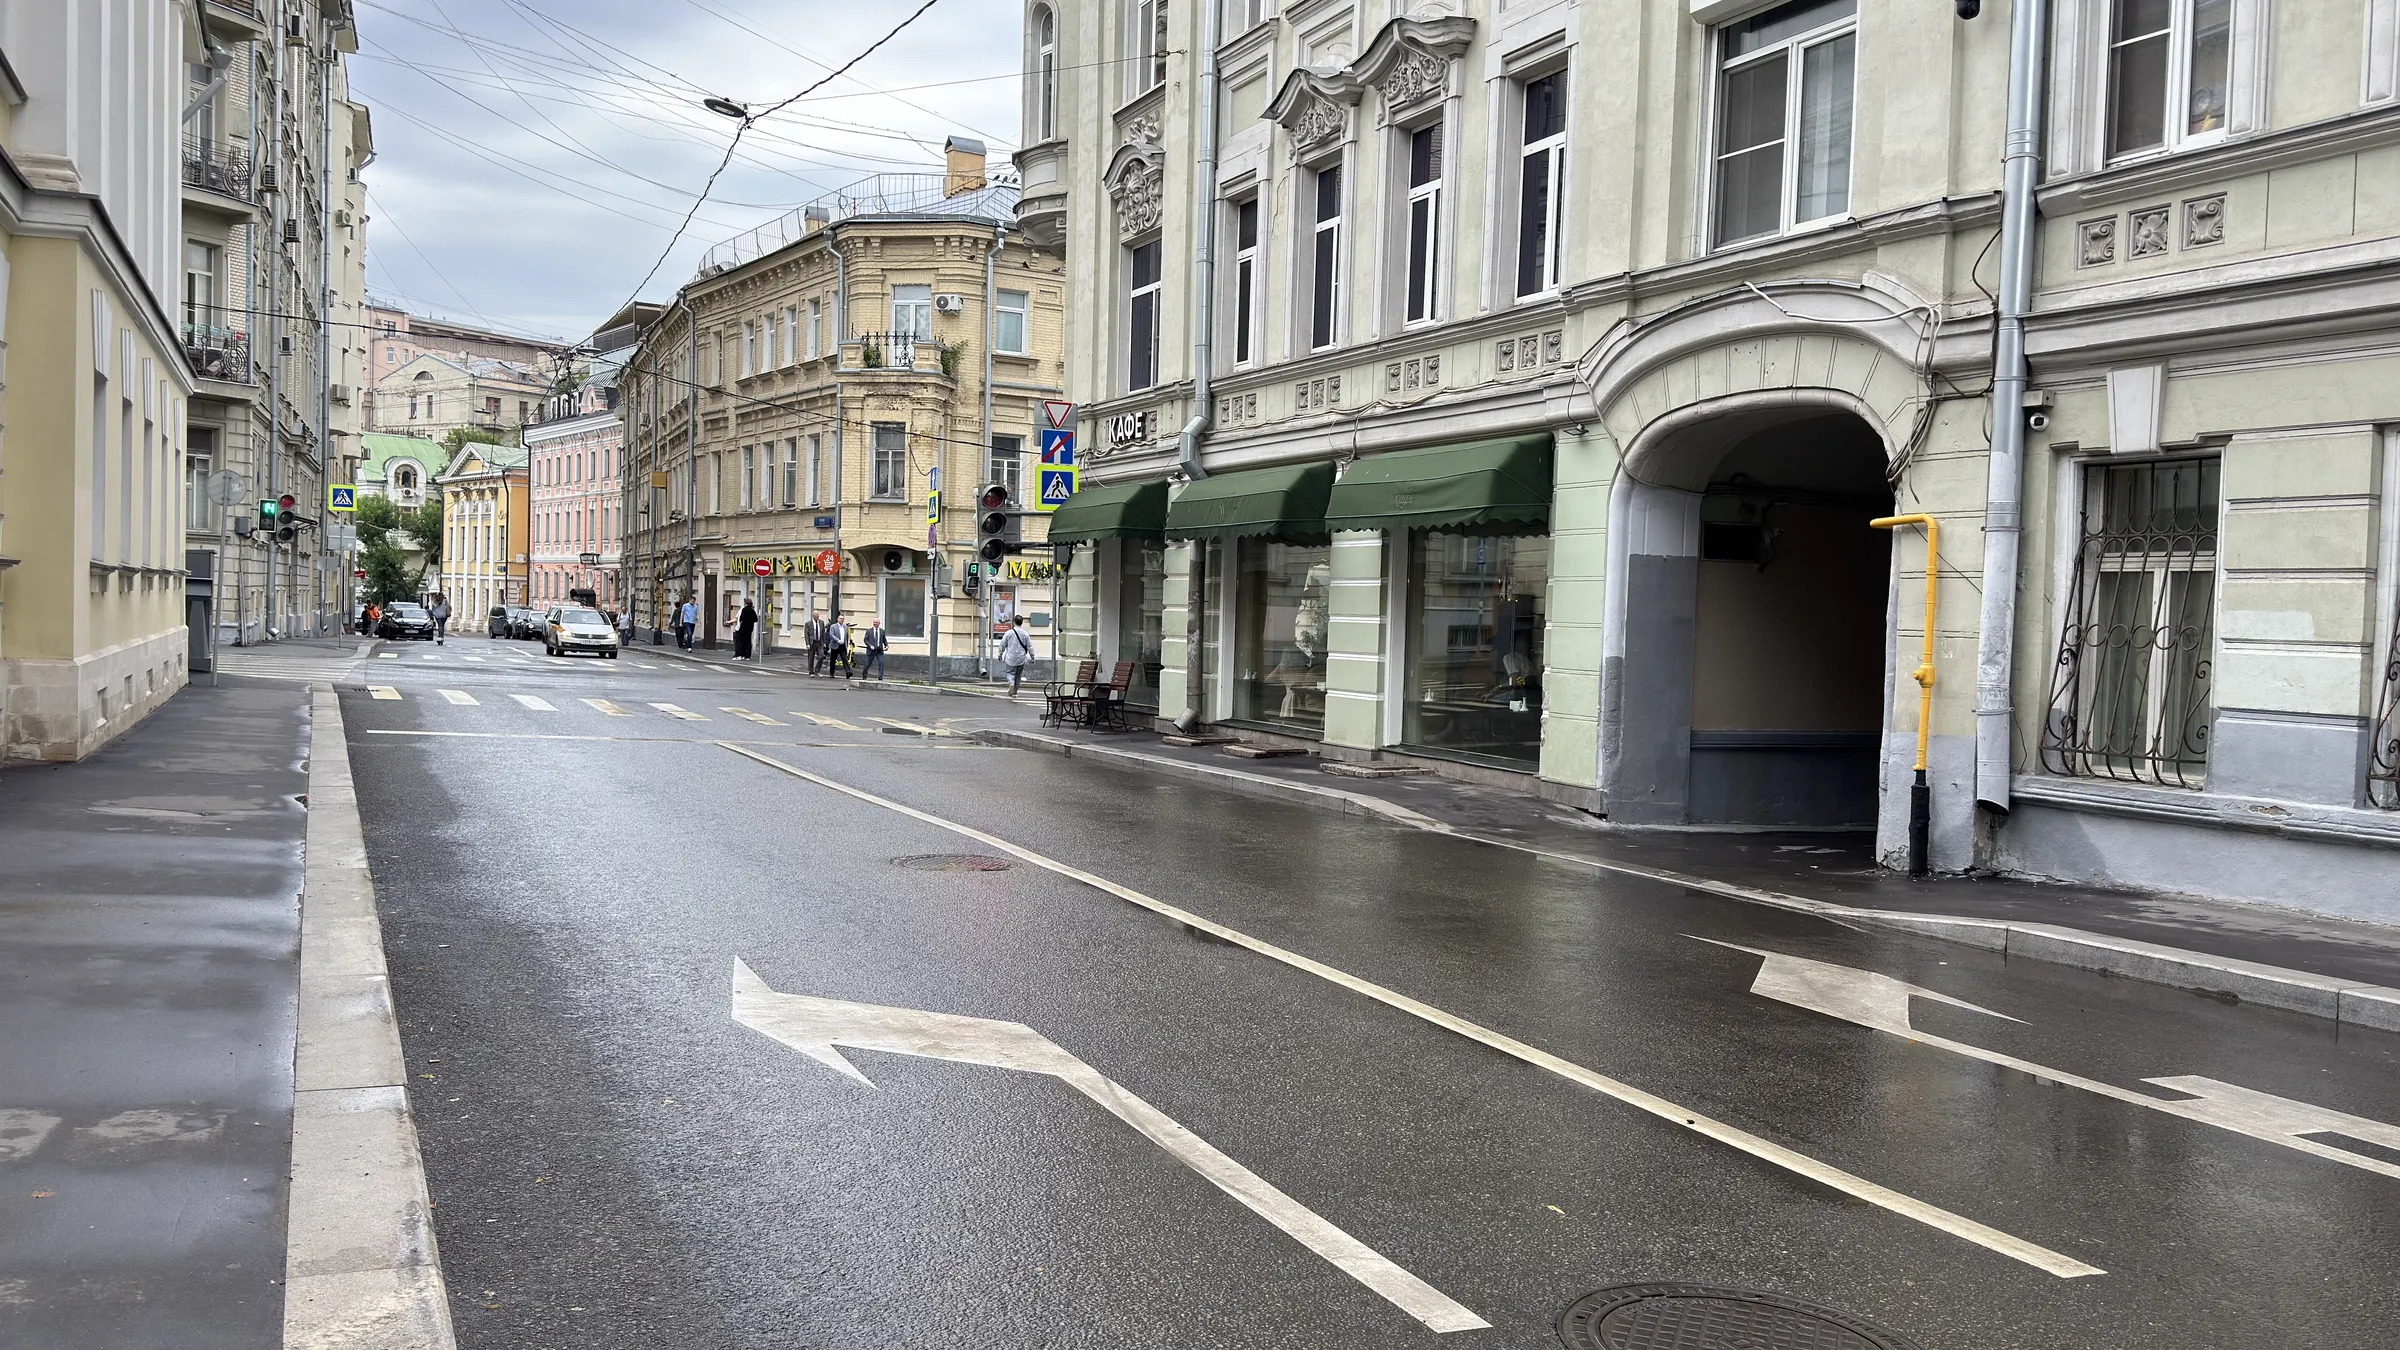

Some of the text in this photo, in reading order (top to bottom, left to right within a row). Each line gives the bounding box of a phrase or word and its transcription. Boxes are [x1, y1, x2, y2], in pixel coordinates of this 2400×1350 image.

[1108, 411, 1143, 443] КАФЕ
[731, 556, 816, 574] МАГНЯ МАР
[825, 554, 834, 562] 24
